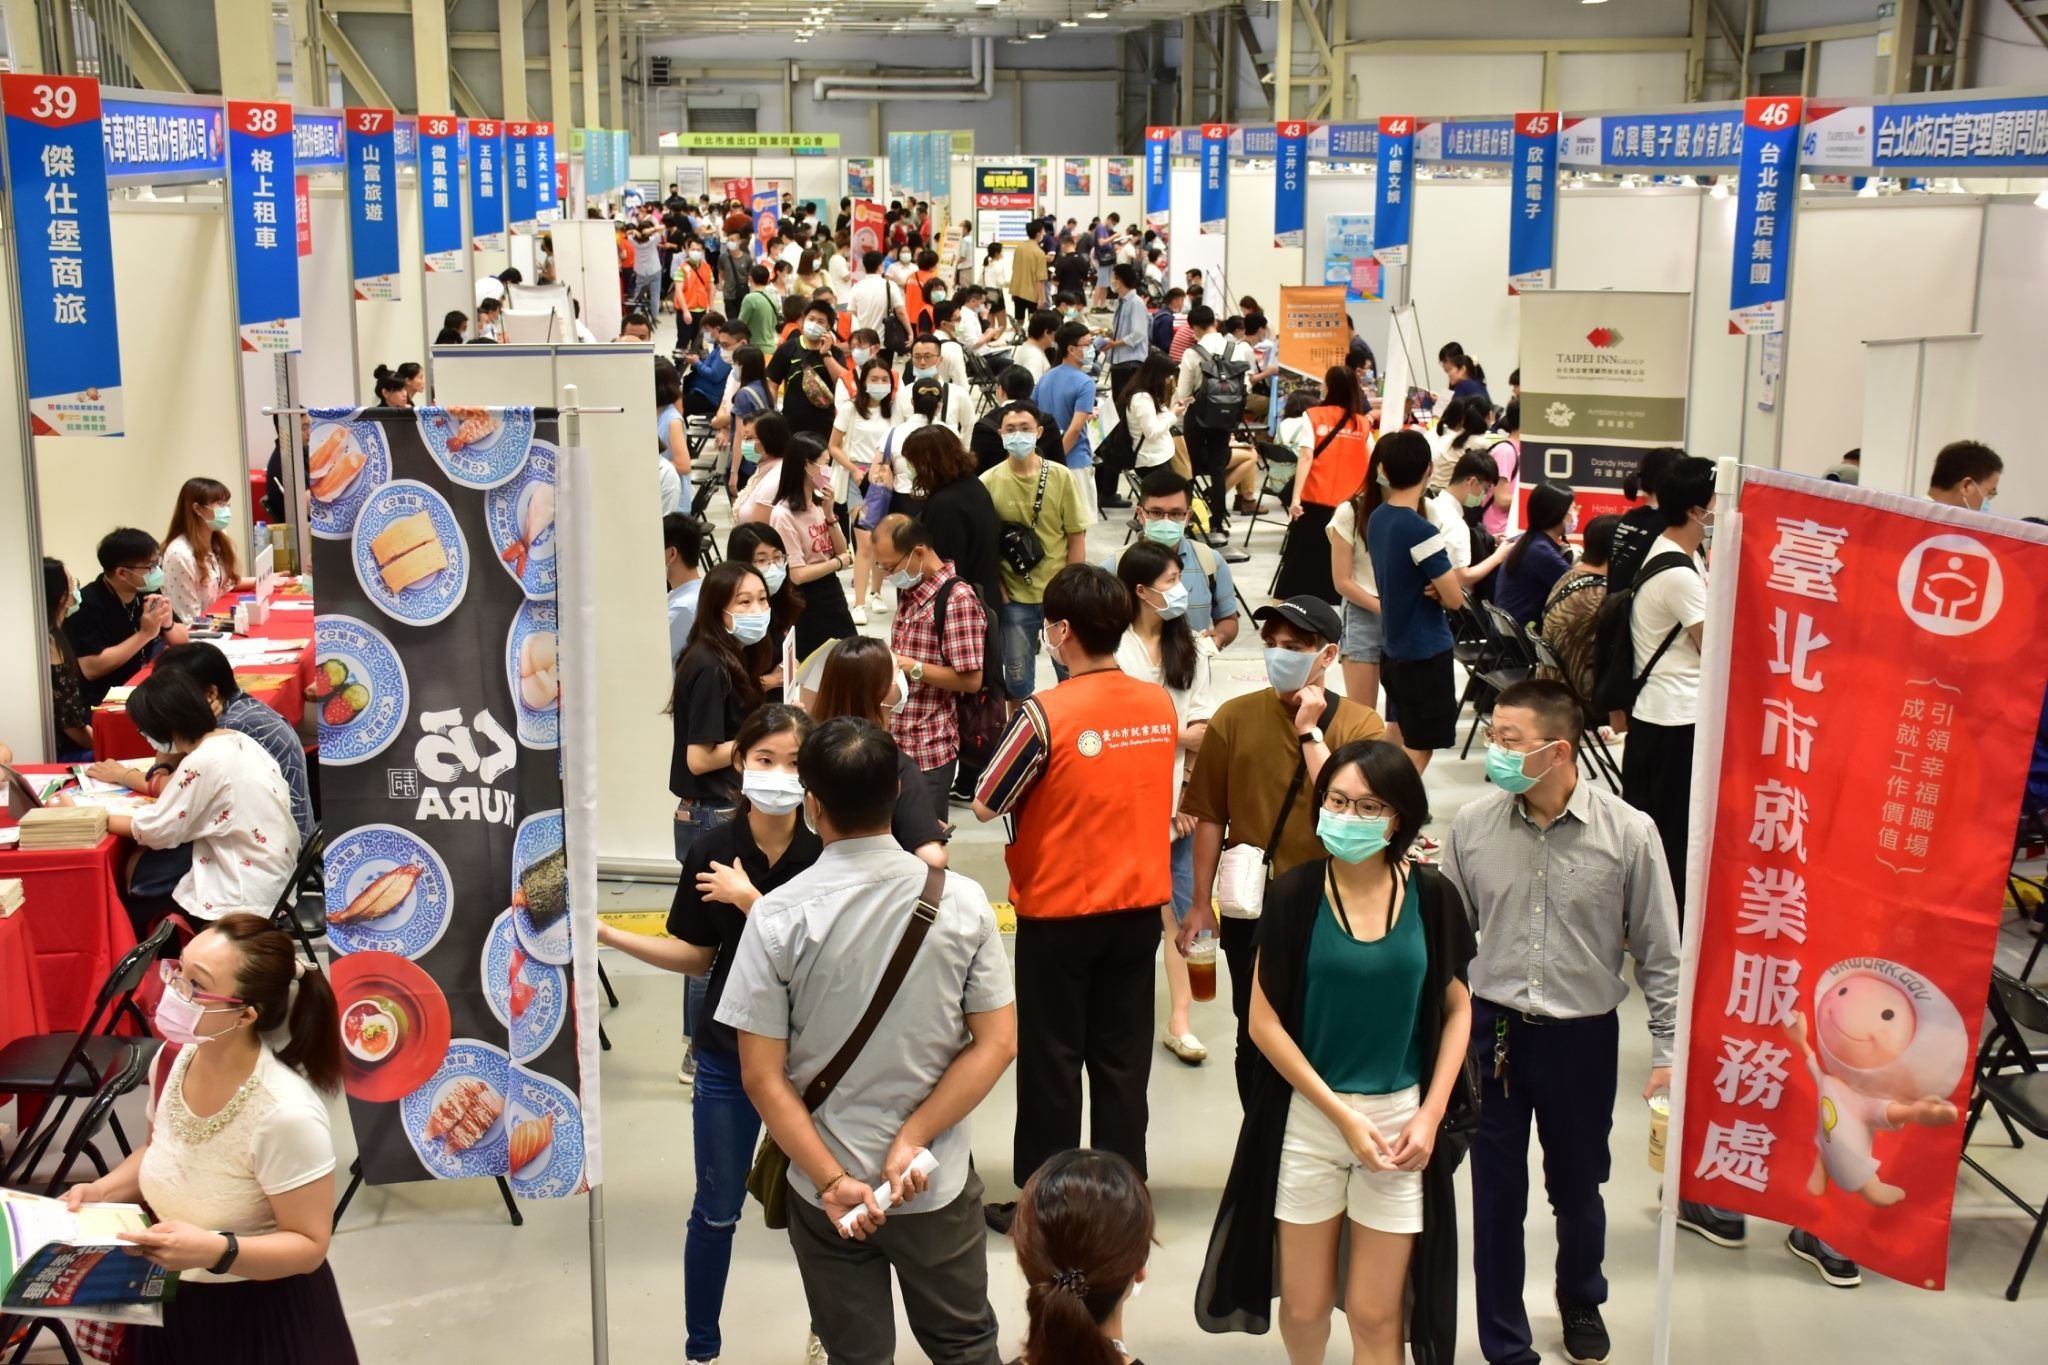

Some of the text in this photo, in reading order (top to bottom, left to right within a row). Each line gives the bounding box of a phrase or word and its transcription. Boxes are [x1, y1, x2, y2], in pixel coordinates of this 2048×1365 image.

[31, 85, 77, 119] 39
[246, 108, 278, 132] 38
[359, 113, 383, 132] 37
[1526, 116, 1549, 134] 45
[1759, 103, 1790, 126] 46
[429, 119, 449, 135] 36
[477, 123, 494, 136] 35
[513, 125, 528, 136] 34
[536, 125, 549, 136] 33
[1152, 129, 1164, 140] 41
[1208, 127, 1223, 138] 42
[1284, 124, 1301, 137] 43
[1388, 119, 1408, 134] 44
[1803, 132, 1817, 155] 46
[431, 144, 449, 208] 微風集團
[480, 145, 494, 198] 王品集團
[1284, 145, 1297, 191] 三井3C
[1387, 144, 1403, 204] 小鹿文娛
[362, 144, 383, 221] 山富旅遊
[1525, 146, 1543, 219] 欣興電子
[250, 149, 278, 249] 格上租車
[1751, 142, 1781, 285] 台北旅店集團
[41, 144, 87, 325] 傑仕堡商旅
[1556, 353, 1594, 364] TAIPEI
[1596, 354, 1617, 365] INN
[1591, 458, 1638, 468] Dandy Hotel
[1591, 504, 1618, 513] Hotel
[1878, 698, 1926, 852] 成就工作價值
[1903, 702, 1954, 858] 引領幸福職場
[1694, 516, 1849, 1194] 臺北市就業服務處
